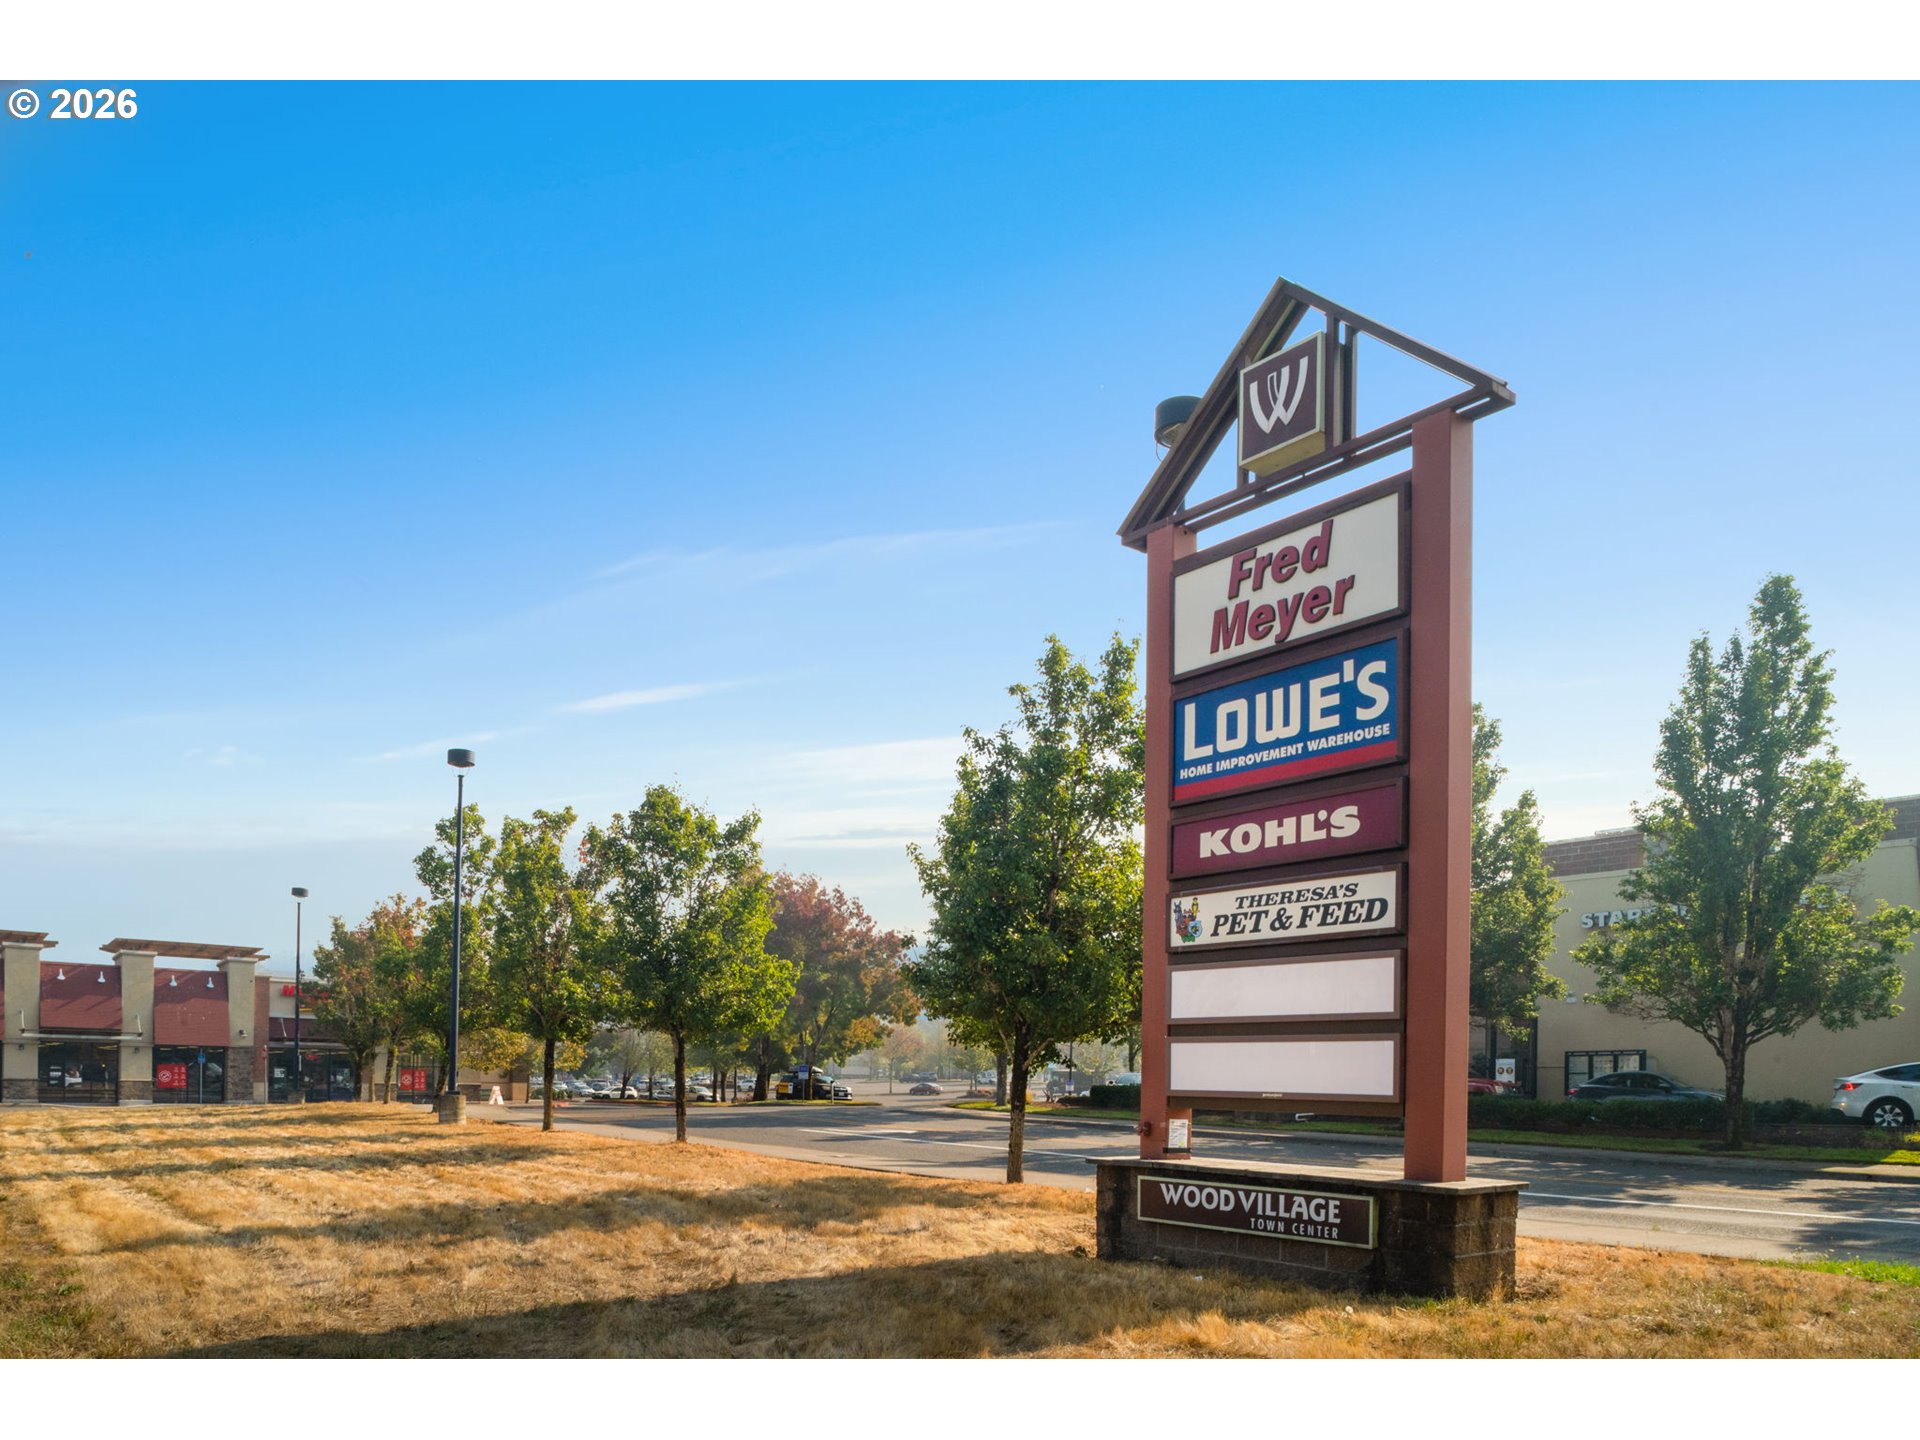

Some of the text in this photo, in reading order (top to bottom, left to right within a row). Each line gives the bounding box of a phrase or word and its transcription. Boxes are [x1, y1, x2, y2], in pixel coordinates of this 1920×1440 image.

[1249, 355, 1309, 434] W
[1228, 518, 1334, 600] Fred
[1210, 574, 1356, 654] Meyer
[1184, 658, 1390, 761] LOWE'S
[1180, 722, 1391, 780] HOME IMPROVEMENT WAREHOUSE
[1199, 805, 1361, 859] KOHL'S
[1210, 897, 1389, 937] PET & FEED
[1235, 882, 1359, 910] THERESA'S
[1160, 1183, 1342, 1224] WOOD VILLAGE
[1250, 1217, 1339, 1240] TOWN CENTER
